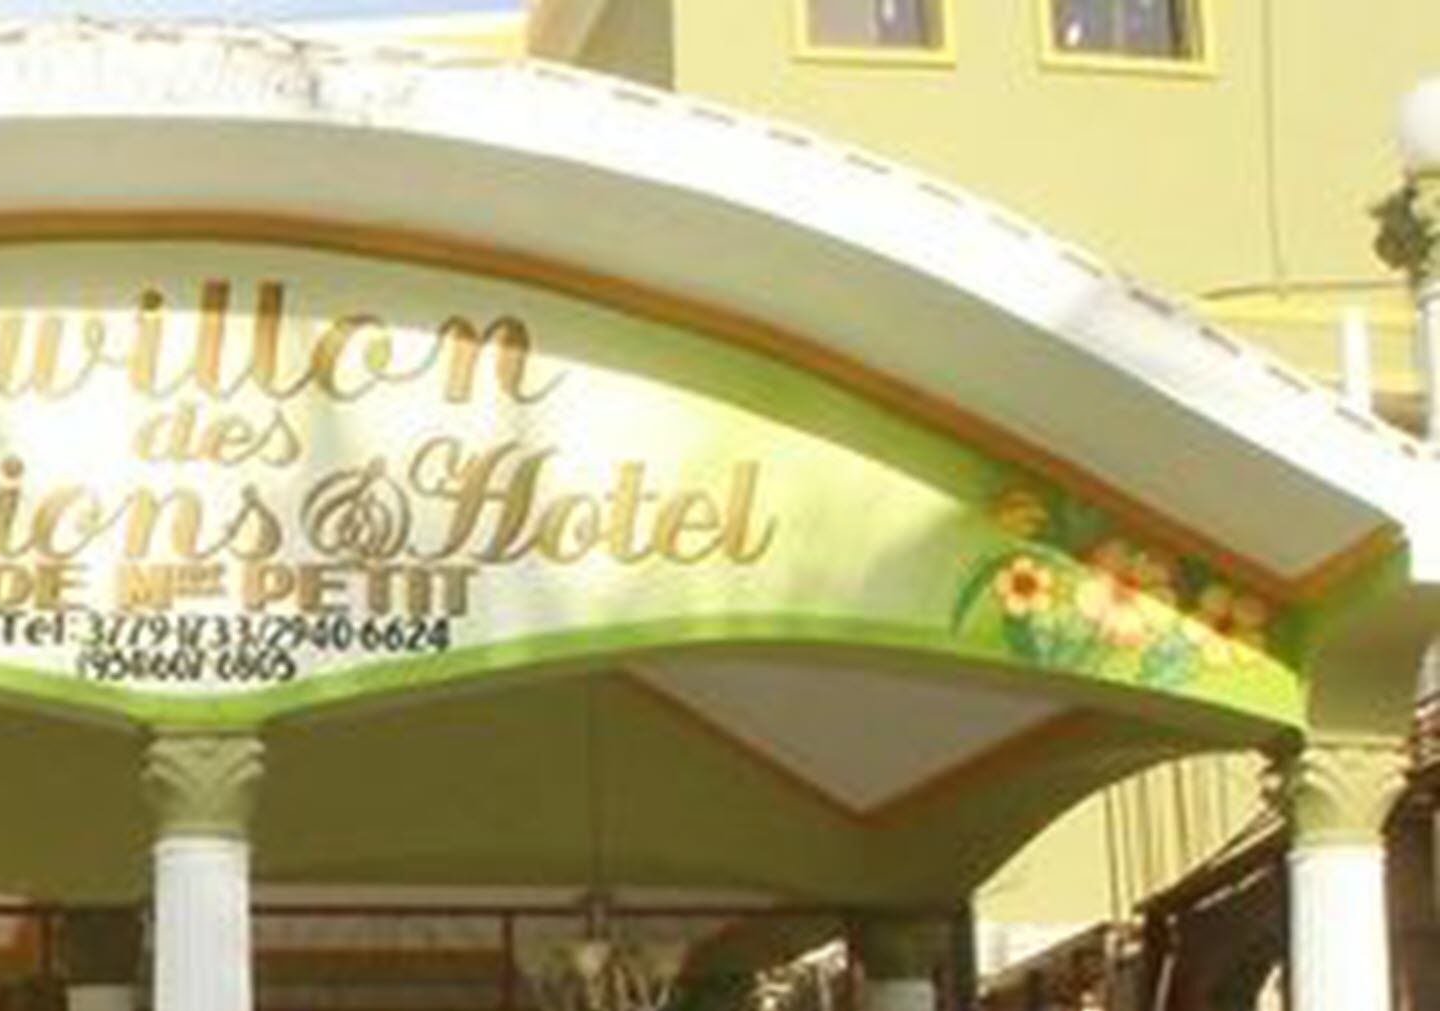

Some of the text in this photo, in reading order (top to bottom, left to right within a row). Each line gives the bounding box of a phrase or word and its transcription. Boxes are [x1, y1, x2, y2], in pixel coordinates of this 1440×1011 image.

[135, 402, 302, 467] des
[408, 436, 776, 564] Hotel
[240, 562, 477, 617] PETIT
